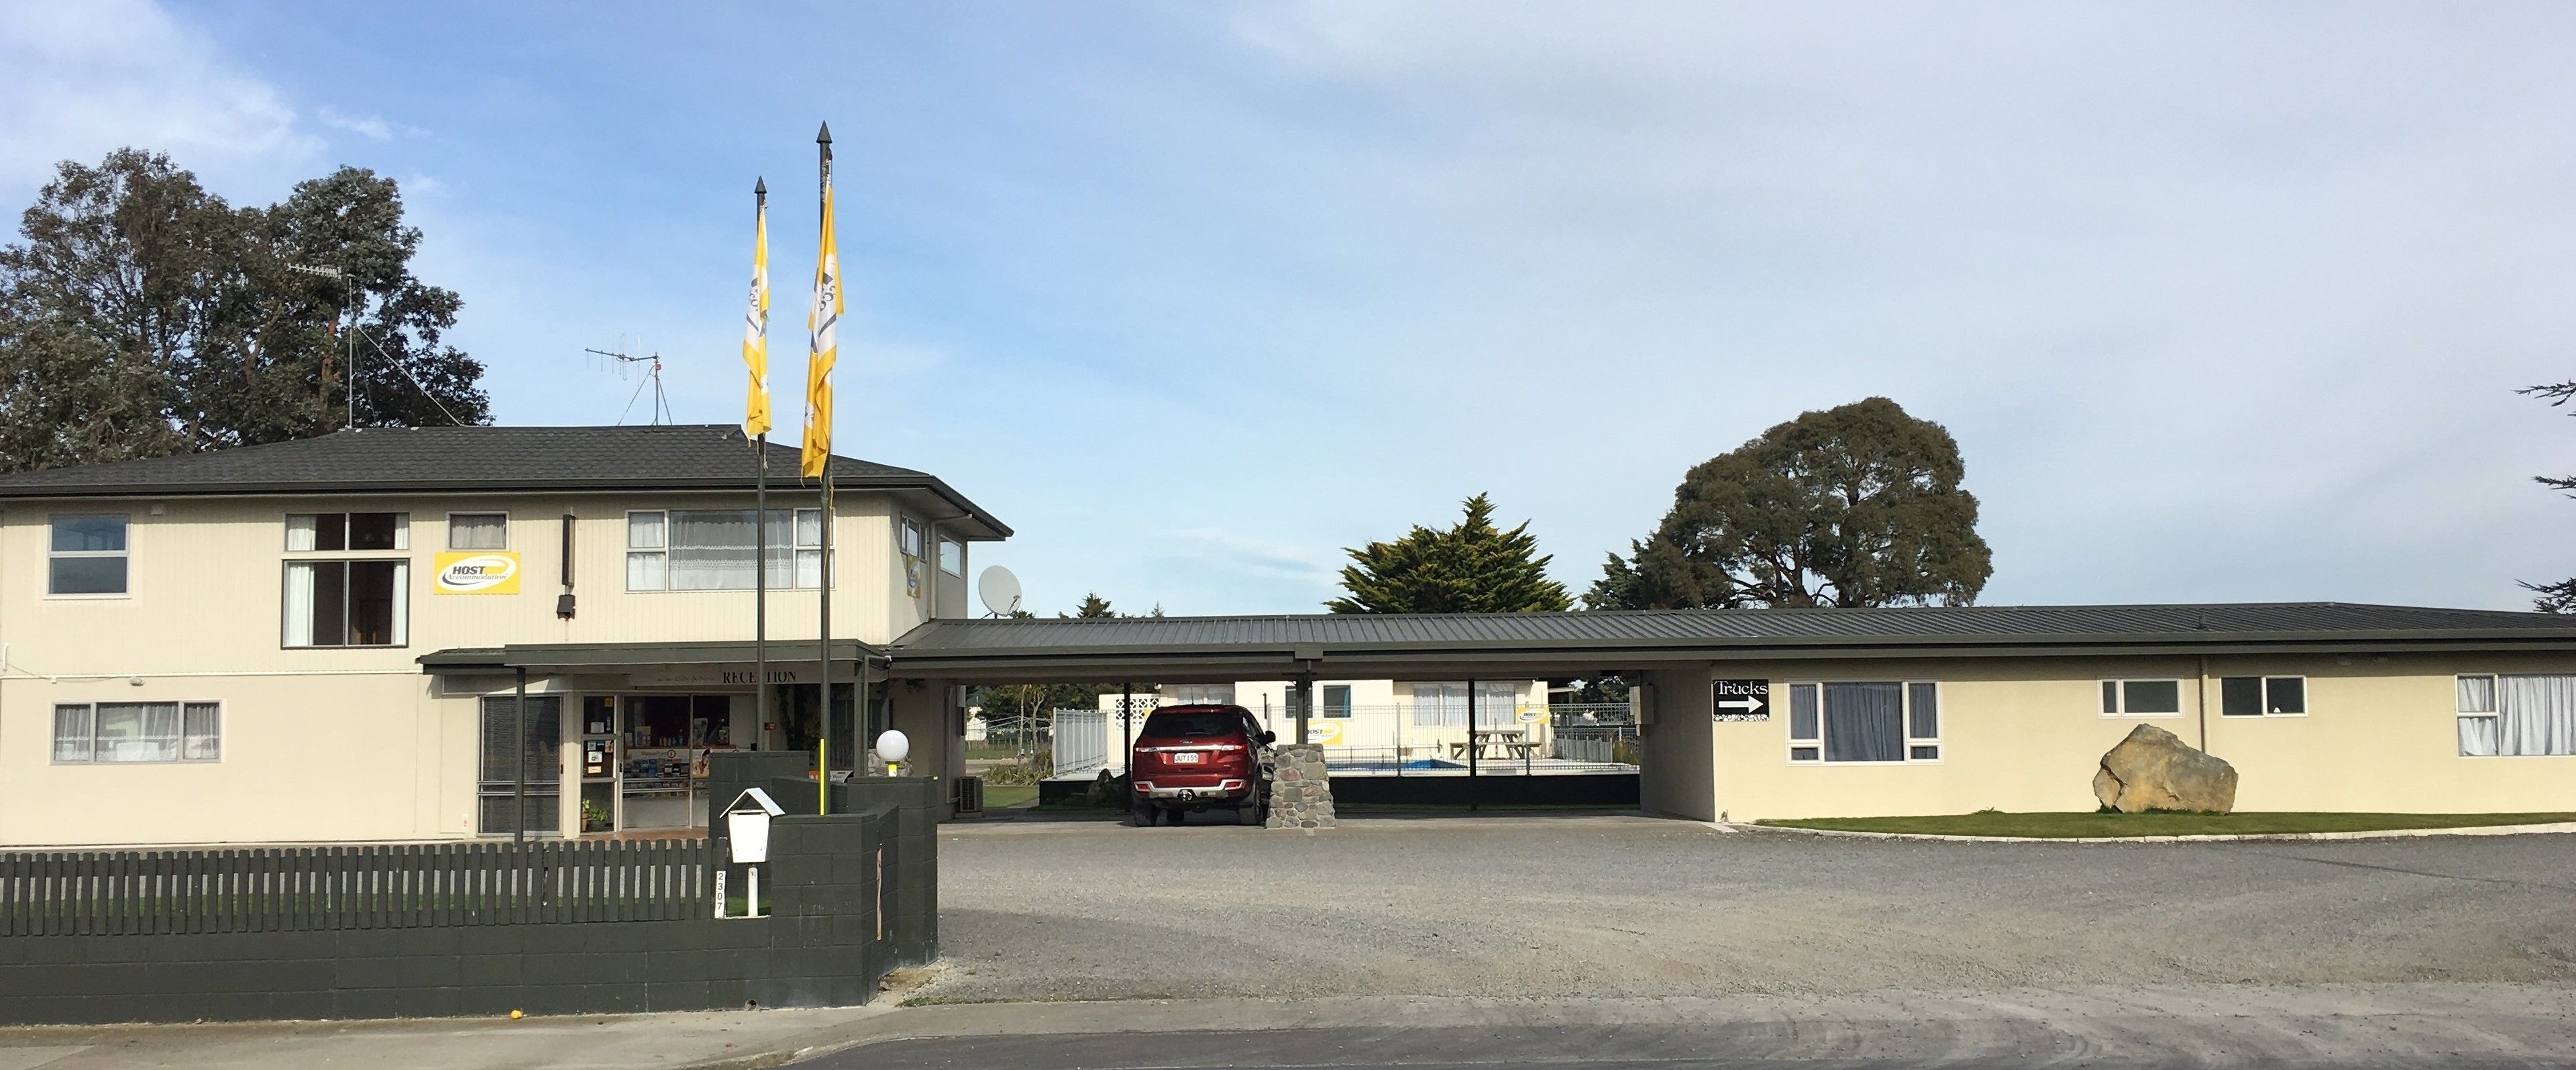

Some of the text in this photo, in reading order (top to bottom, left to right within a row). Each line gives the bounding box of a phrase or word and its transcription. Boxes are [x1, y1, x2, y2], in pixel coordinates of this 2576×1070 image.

[452, 566, 486, 574] HOST
[723, 672, 796, 684] RECETION
[1713, 680, 1768, 695] Trucks
